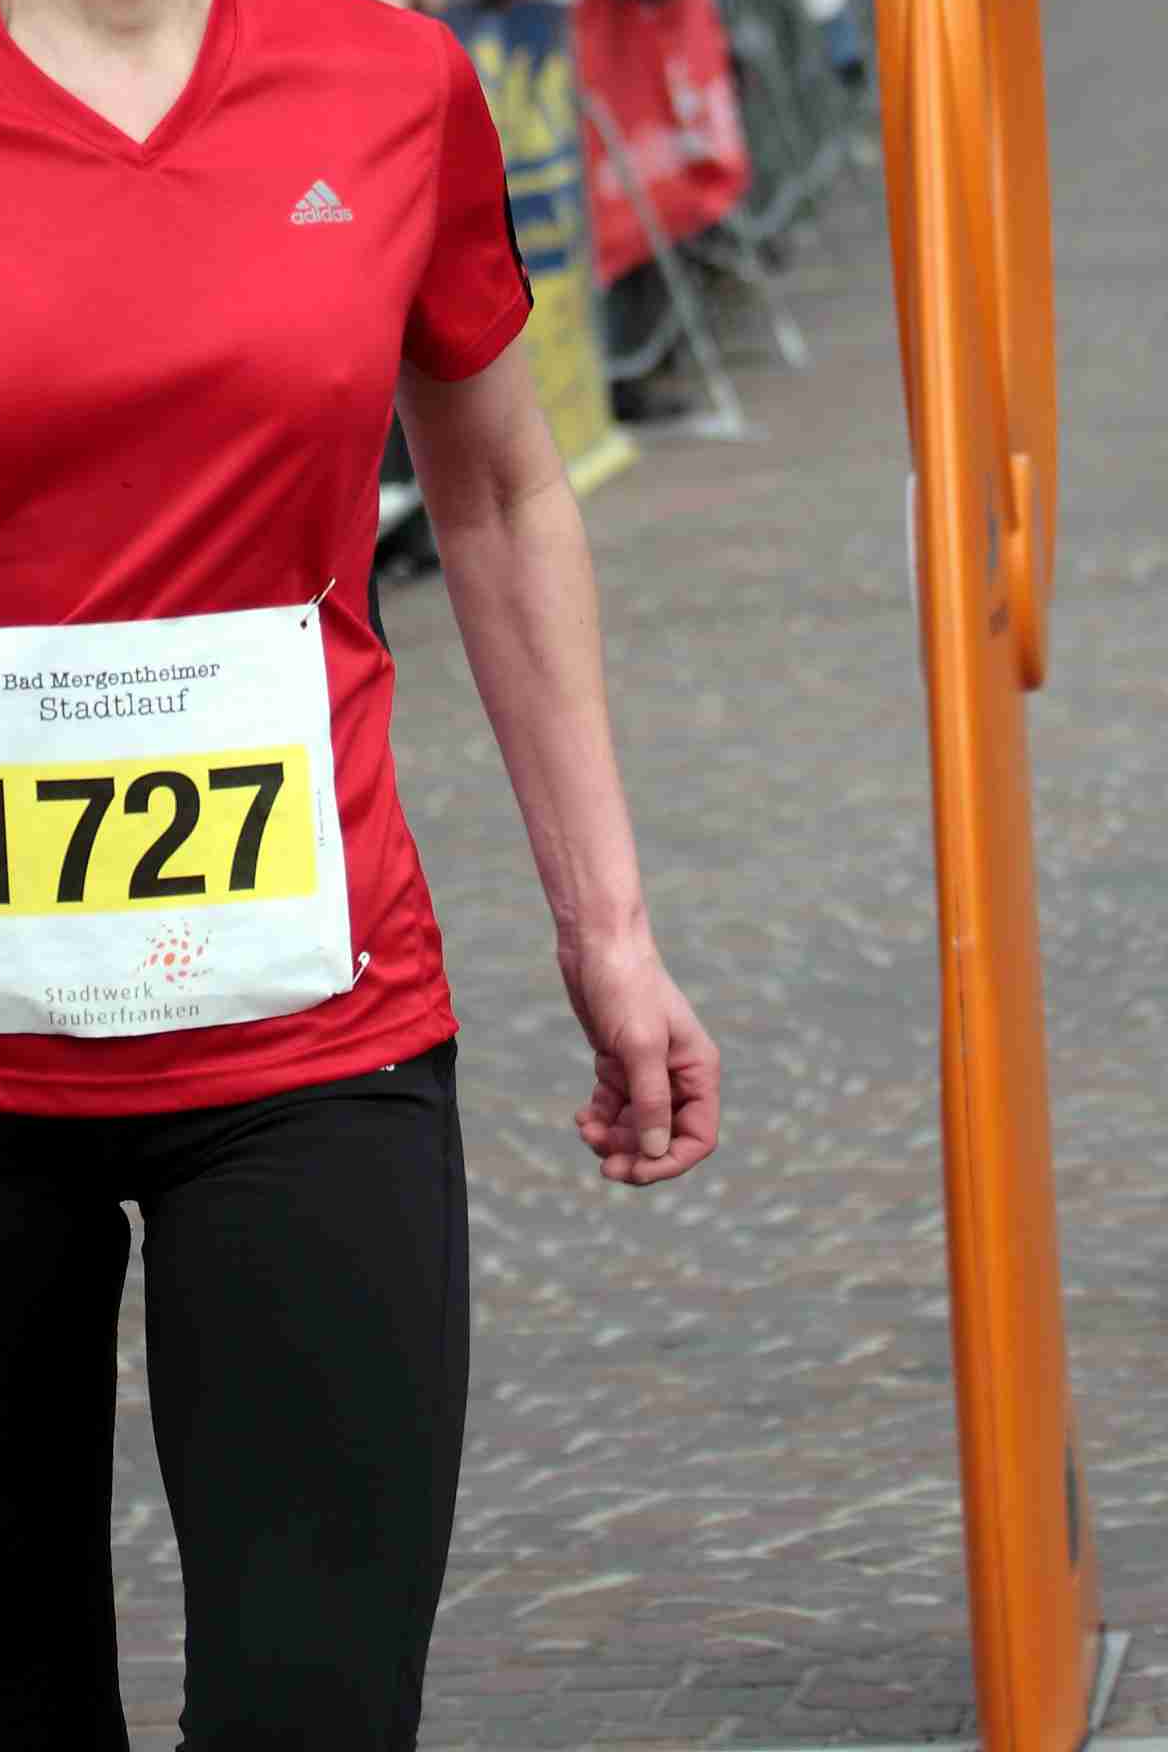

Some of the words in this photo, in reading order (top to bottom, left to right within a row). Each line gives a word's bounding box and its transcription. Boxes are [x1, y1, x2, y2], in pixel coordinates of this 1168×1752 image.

[290, 205, 353, 225] adidas
[2, 672, 44, 691] Bad
[49, 662, 221, 690] Mergentheimer
[38, 687, 190, 722] Stadtlauf
[44, 981, 154, 1003] Stadtwerk
[47, 1002, 201, 1026] Tauberfranken
